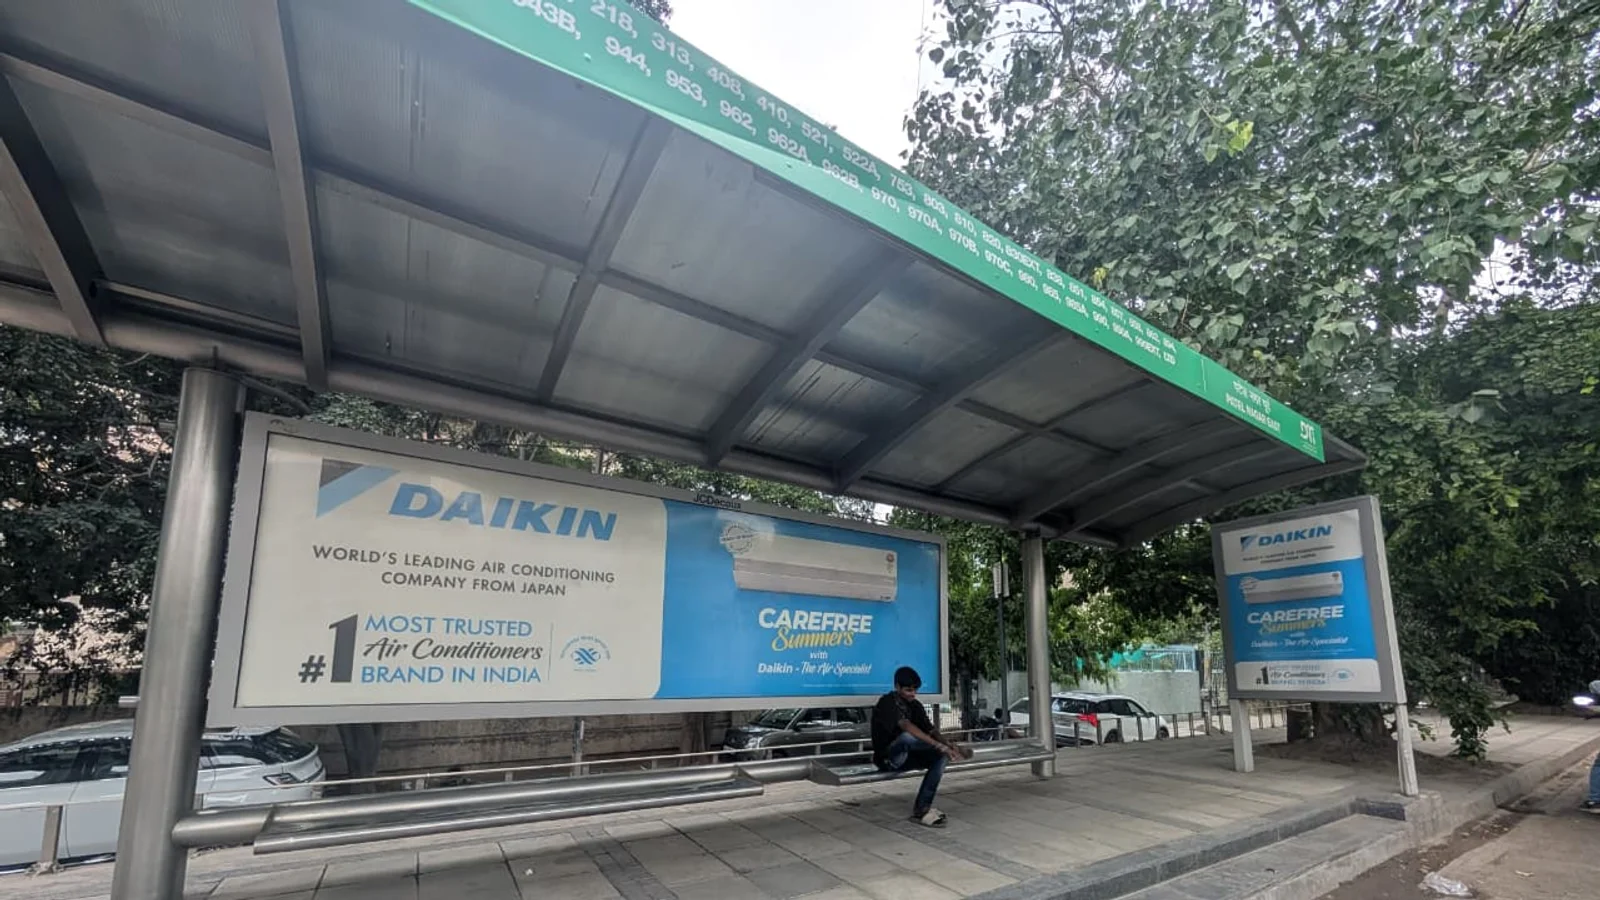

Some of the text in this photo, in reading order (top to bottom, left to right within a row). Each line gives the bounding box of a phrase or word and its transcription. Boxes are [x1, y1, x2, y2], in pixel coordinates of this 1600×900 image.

[605, 36, 651, 77] 944,
[666, 69, 707, 107] 953,
[720, 100, 756, 136] 962,
[651, 32, 694, 72] 313,
[707, 67, 745, 101] 408,
[756, 96, 792, 129] 410,
[802, 122, 833, 154] 521,
[842, 148, 881, 181] 522A,
[389, 482, 618, 542] DAIKIN
[1258, 525, 1332, 546] DAIKIN
[404, 551, 475, 573] LEADING
[481, 560, 506, 576] AIR
[511, 563, 615, 583] CONDITIONING
[381, 571, 566, 597] COMPANY FROM JAPAN
[365, 615, 532, 637] MOST TRUSTED
[758, 607, 873, 634] CAREFREE
[1247, 605, 1345, 624] CAREFREE
[362, 637, 408, 662] Air
[412, 637, 543, 662] Conditioners
[771, 626, 855, 651] Summers
[809, 650, 828, 659] with
[361, 665, 541, 684] BRAND IN INDIA
[757, 662, 793, 674] Daikin
